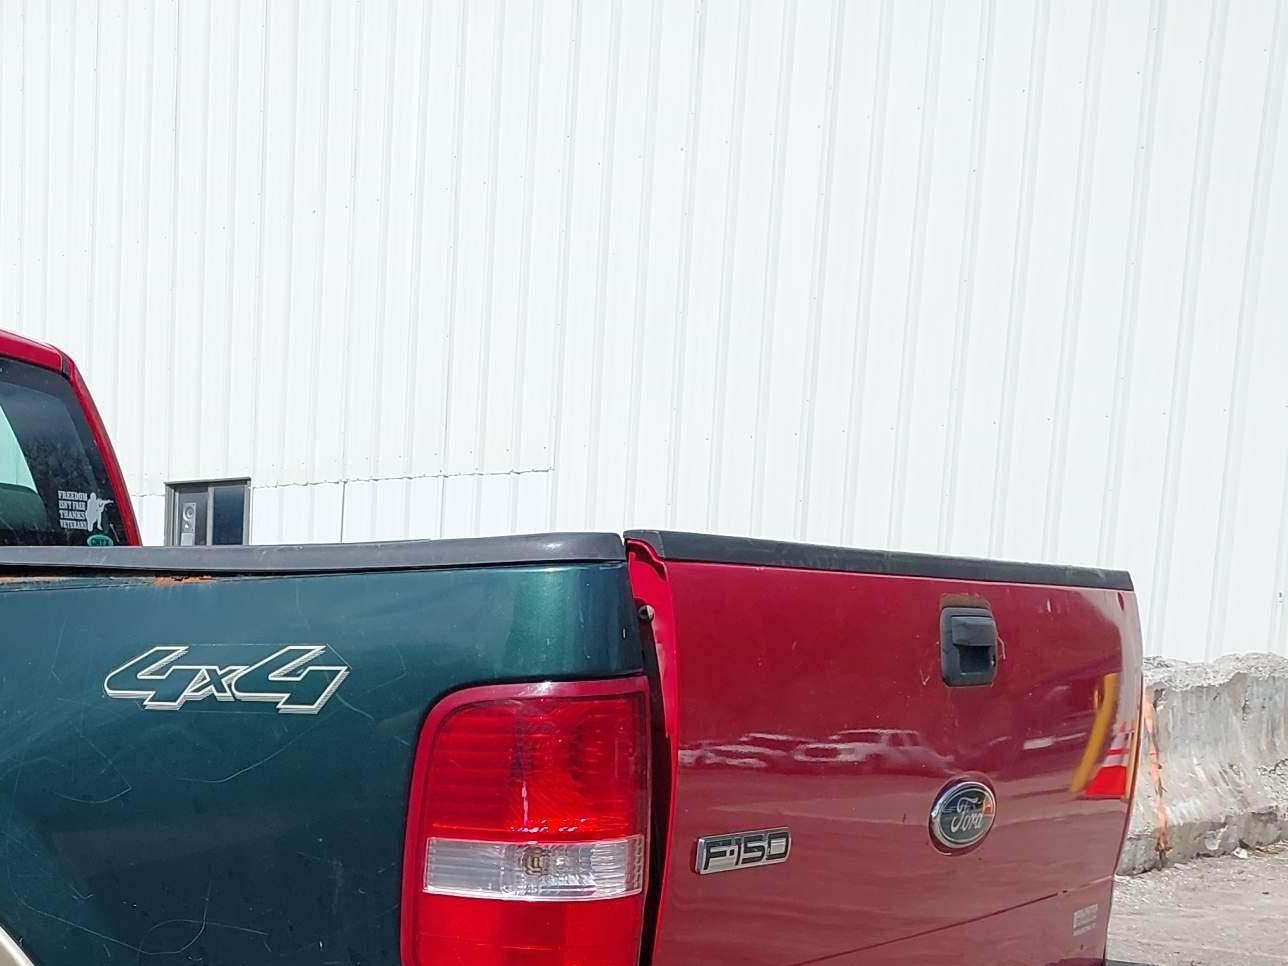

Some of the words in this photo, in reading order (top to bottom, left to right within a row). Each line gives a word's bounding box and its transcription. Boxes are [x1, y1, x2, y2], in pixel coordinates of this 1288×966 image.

[58, 491, 87, 501] FREEDOM
[59, 510, 86, 520] THANKS
[104, 645, 350, 714] 4x4
[950, 796, 984, 833] Ford
